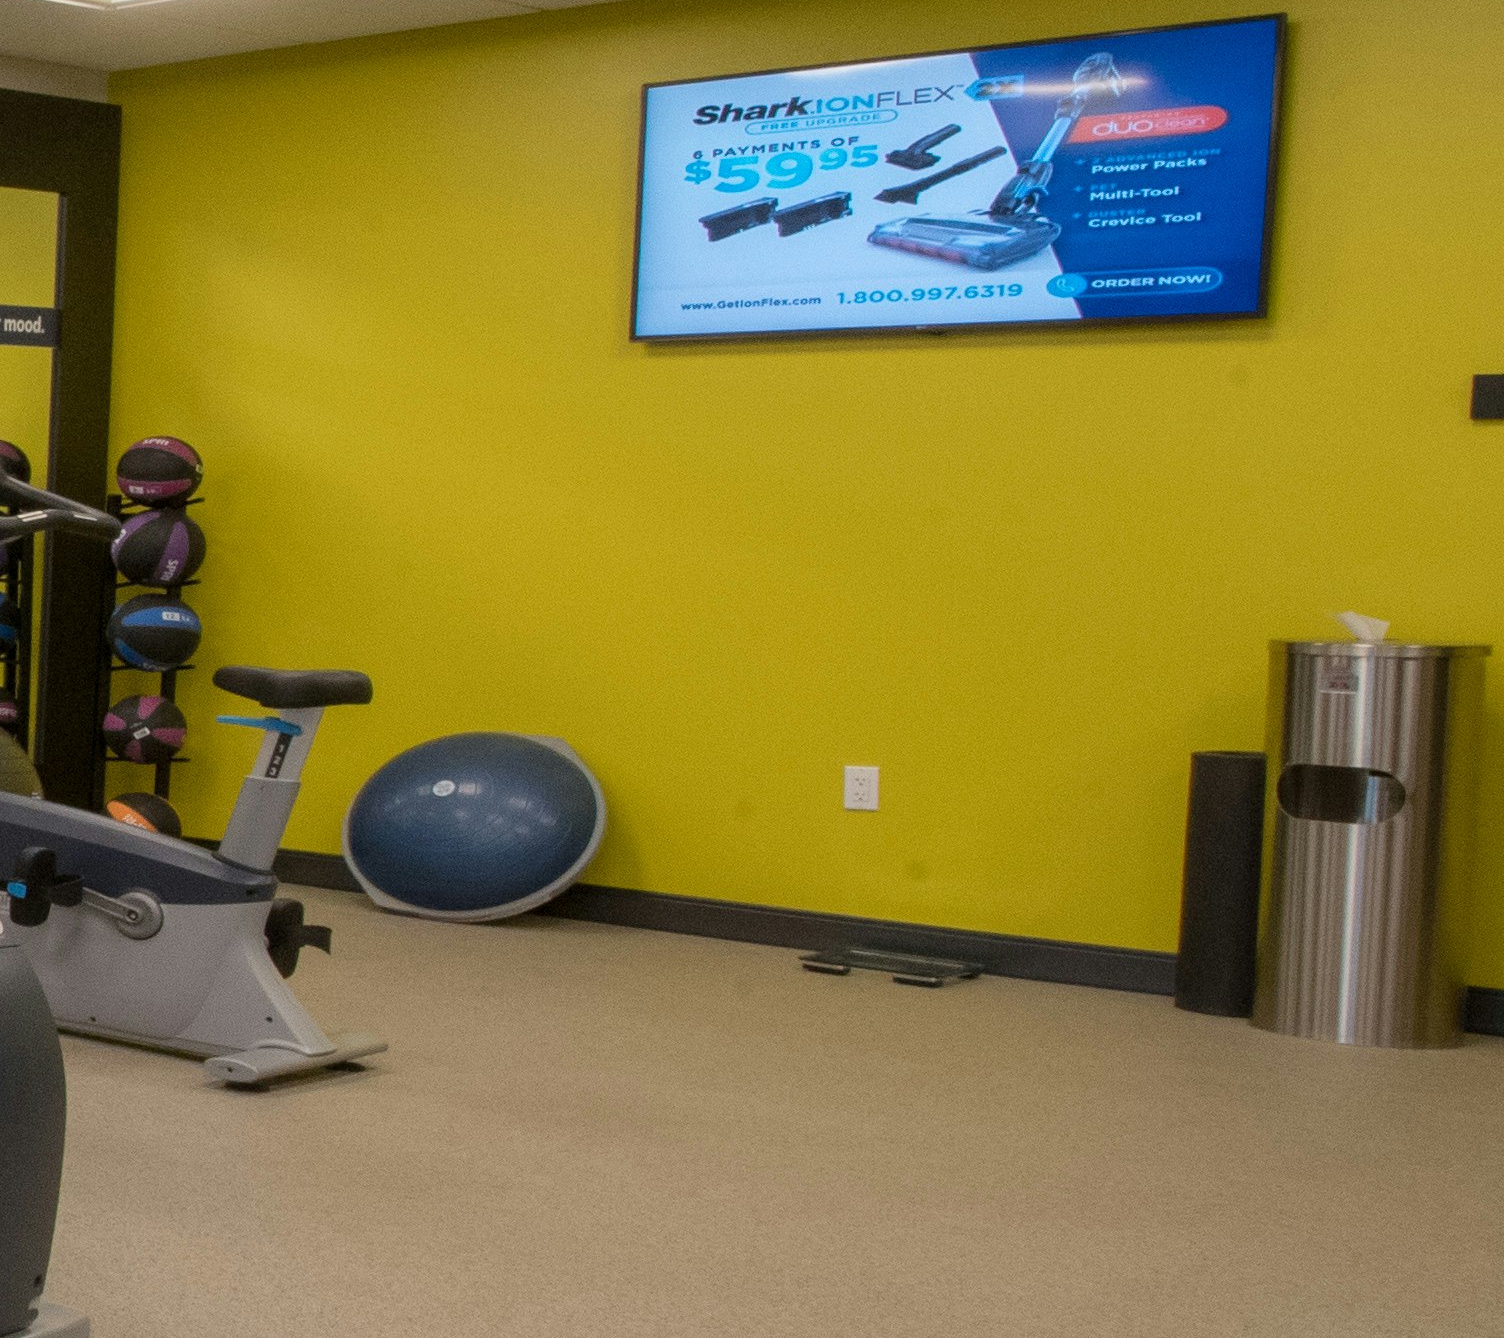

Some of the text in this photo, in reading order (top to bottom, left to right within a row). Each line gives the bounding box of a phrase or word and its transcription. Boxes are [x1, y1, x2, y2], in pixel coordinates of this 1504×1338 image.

[693, 96, 815, 126] Shark
[760, 120, 799, 132] FREE
[692, 136, 860, 160] 6 PAYMENTS OF
[1091, 157, 1208, 175] Power Packs
[1090, 185, 1180, 202] Multi-Tool
[1088, 212, 1202, 228] Crevice Tool
[1092, 274, 1211, 289] ORDER NOW!
[836, 282, 1023, 306] 1.800.997.6319
[3, 317, 45, 334] mood.
